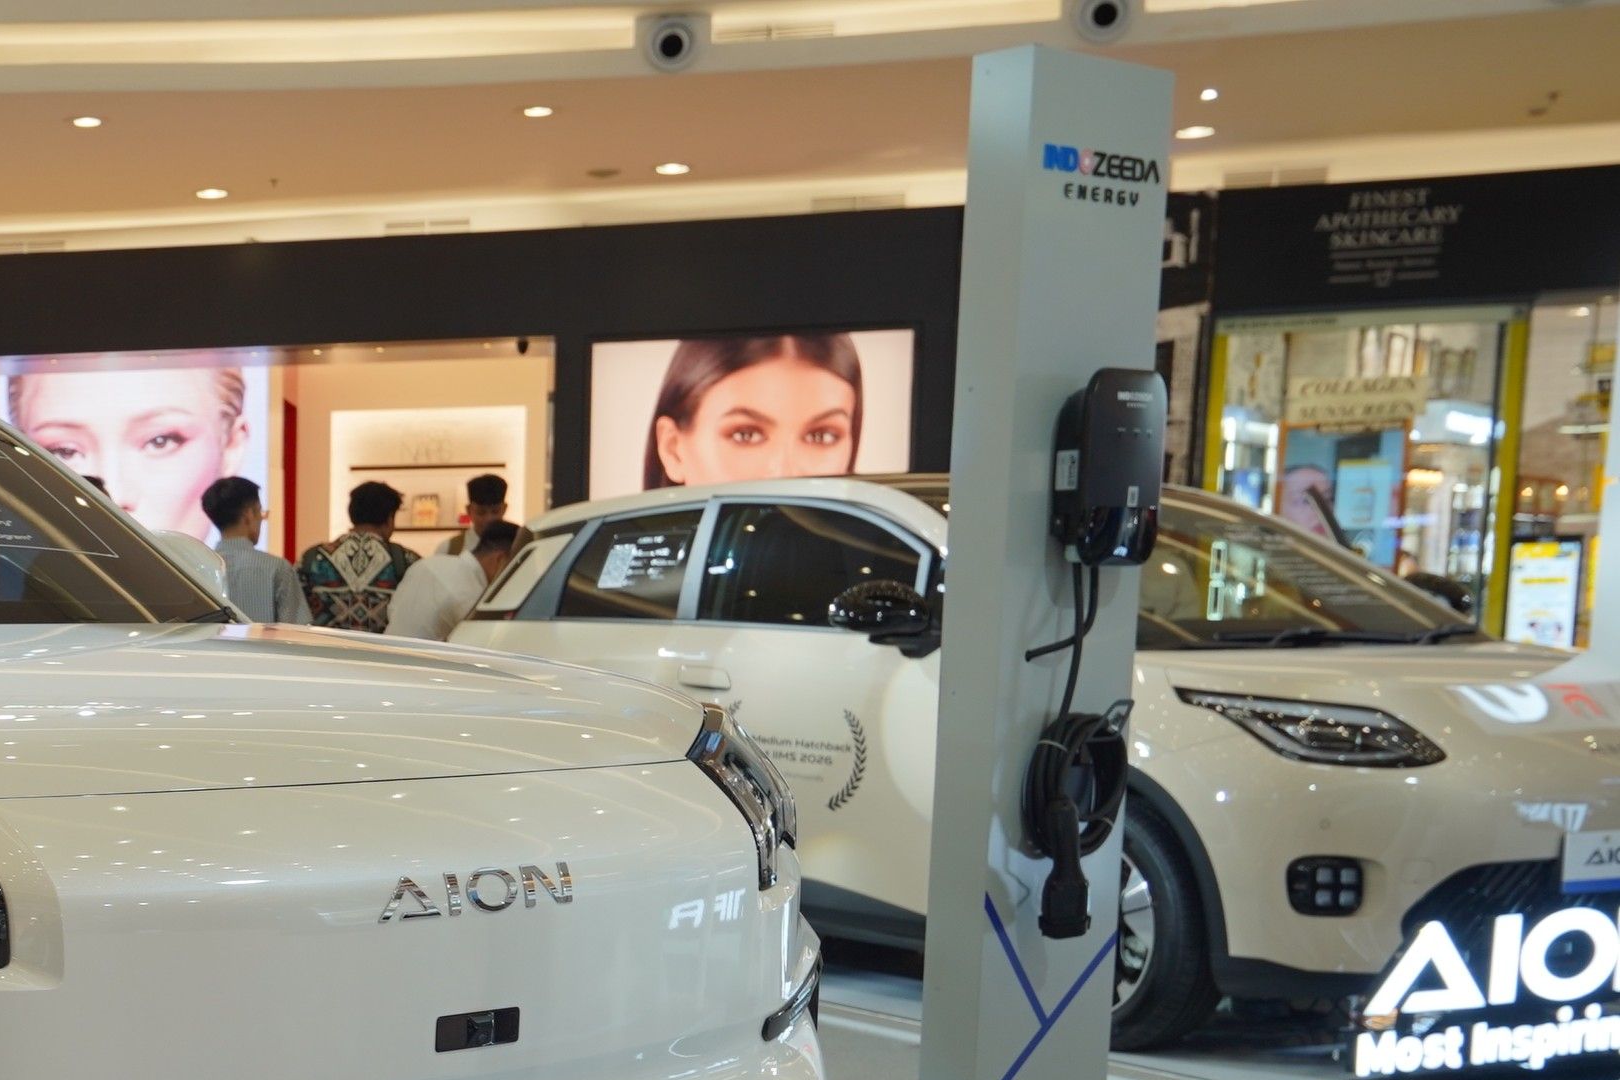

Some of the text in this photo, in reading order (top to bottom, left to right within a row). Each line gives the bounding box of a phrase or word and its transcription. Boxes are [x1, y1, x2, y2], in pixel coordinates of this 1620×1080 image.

[1043, 143, 1160, 184] INDOZEEDA
[1063, 183, 1140, 207] ENERGY
[794, 738, 852, 753] Hatchback
[378, 861, 574, 924] AION
[1362, 906, 1620, 1017] AIO
[1355, 1002, 1620, 1078] Most Inspirin
